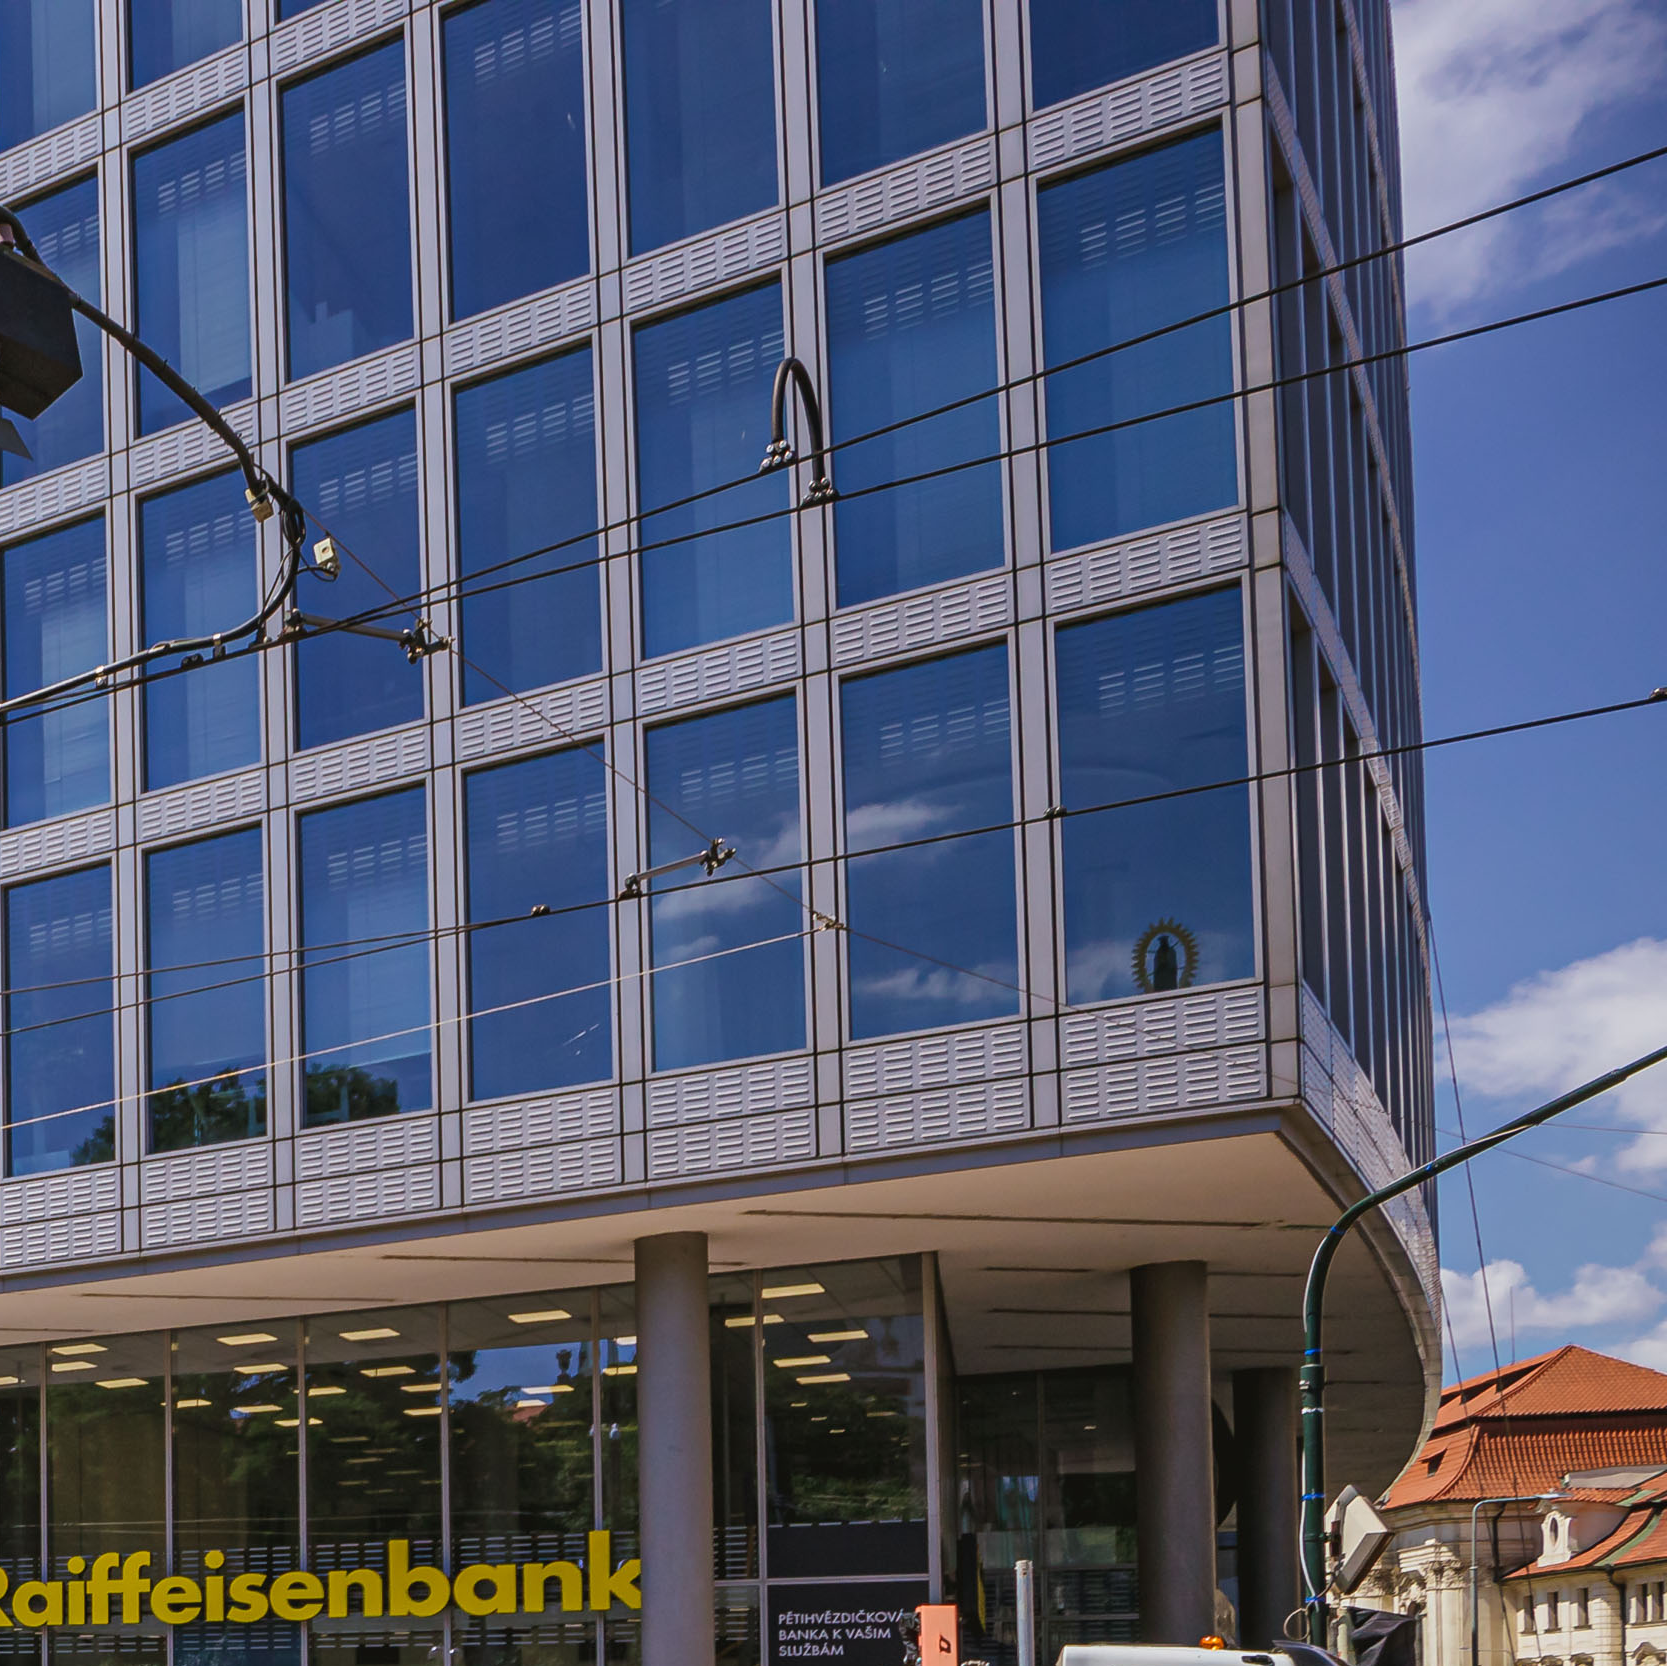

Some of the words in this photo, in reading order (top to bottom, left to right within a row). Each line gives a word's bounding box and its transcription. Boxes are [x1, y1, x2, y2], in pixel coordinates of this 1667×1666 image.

[778, 1629, 829, 1641] BANKA
[832, 1629, 842, 1640] K
[845, 1626, 892, 1640] VAŠIM
[778, 1642, 844, 1657] SLUŽBÁM
